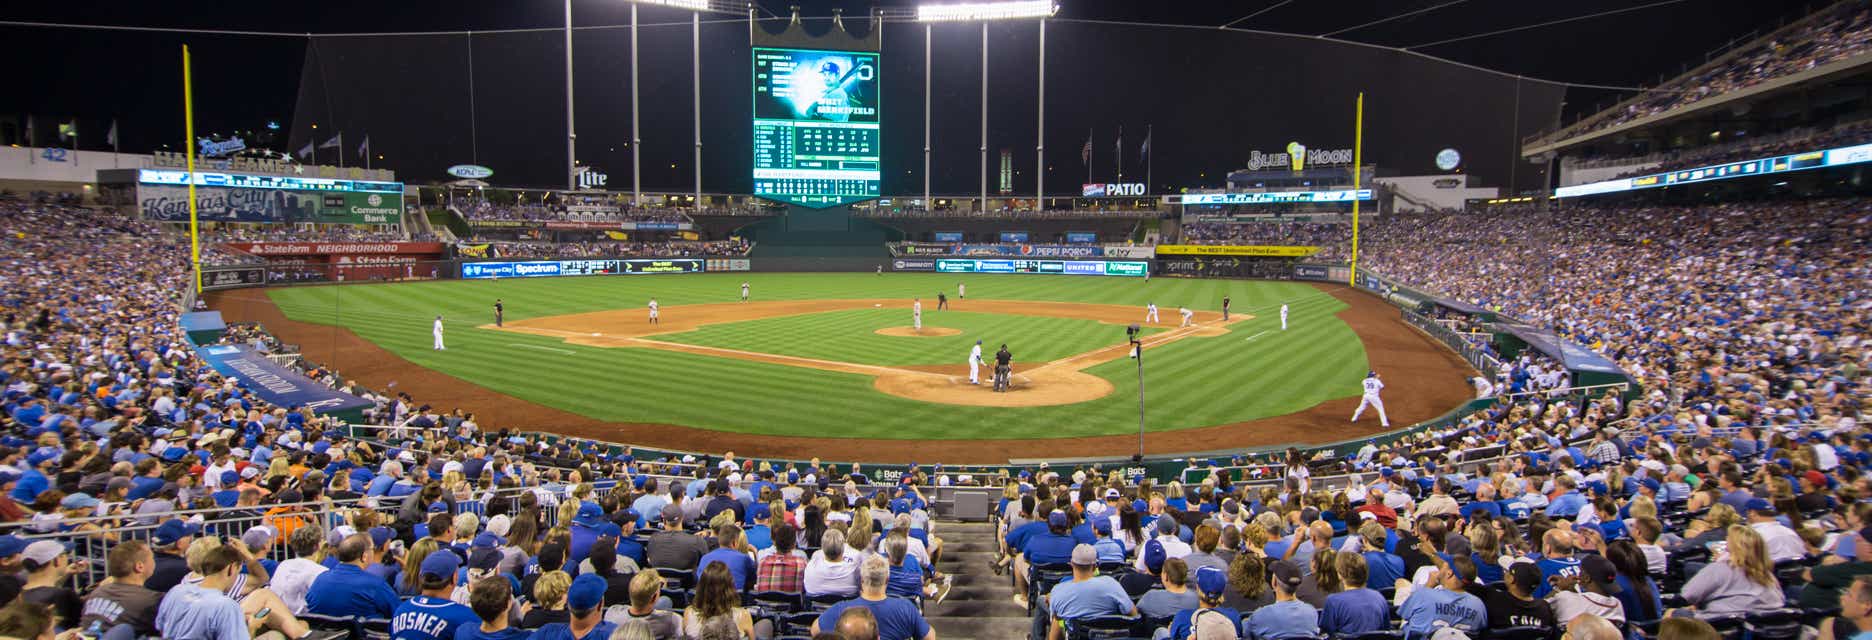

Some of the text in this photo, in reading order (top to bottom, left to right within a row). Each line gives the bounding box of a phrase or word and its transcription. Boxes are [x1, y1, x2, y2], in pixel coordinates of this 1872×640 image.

[41, 147, 67, 161] 42
[1248, 149, 1353, 171] BLUE MOON
[579, 168, 608, 189] Lite
[1106, 183, 1146, 196] PATIO
[227, 188, 267, 212] City
[351, 205, 398, 215] Commerce
[364, 215, 388, 223] Bank
[316, 244, 398, 253] NEIGHBORHOOD
[1036, 247, 1093, 256] PEPSI PORCH
[516, 264, 558, 274] Spectrum
[1117, 263, 1143, 271] National
[1435, 602, 1477, 620] HOSMER
[393, 611, 448, 638] HOSMER
